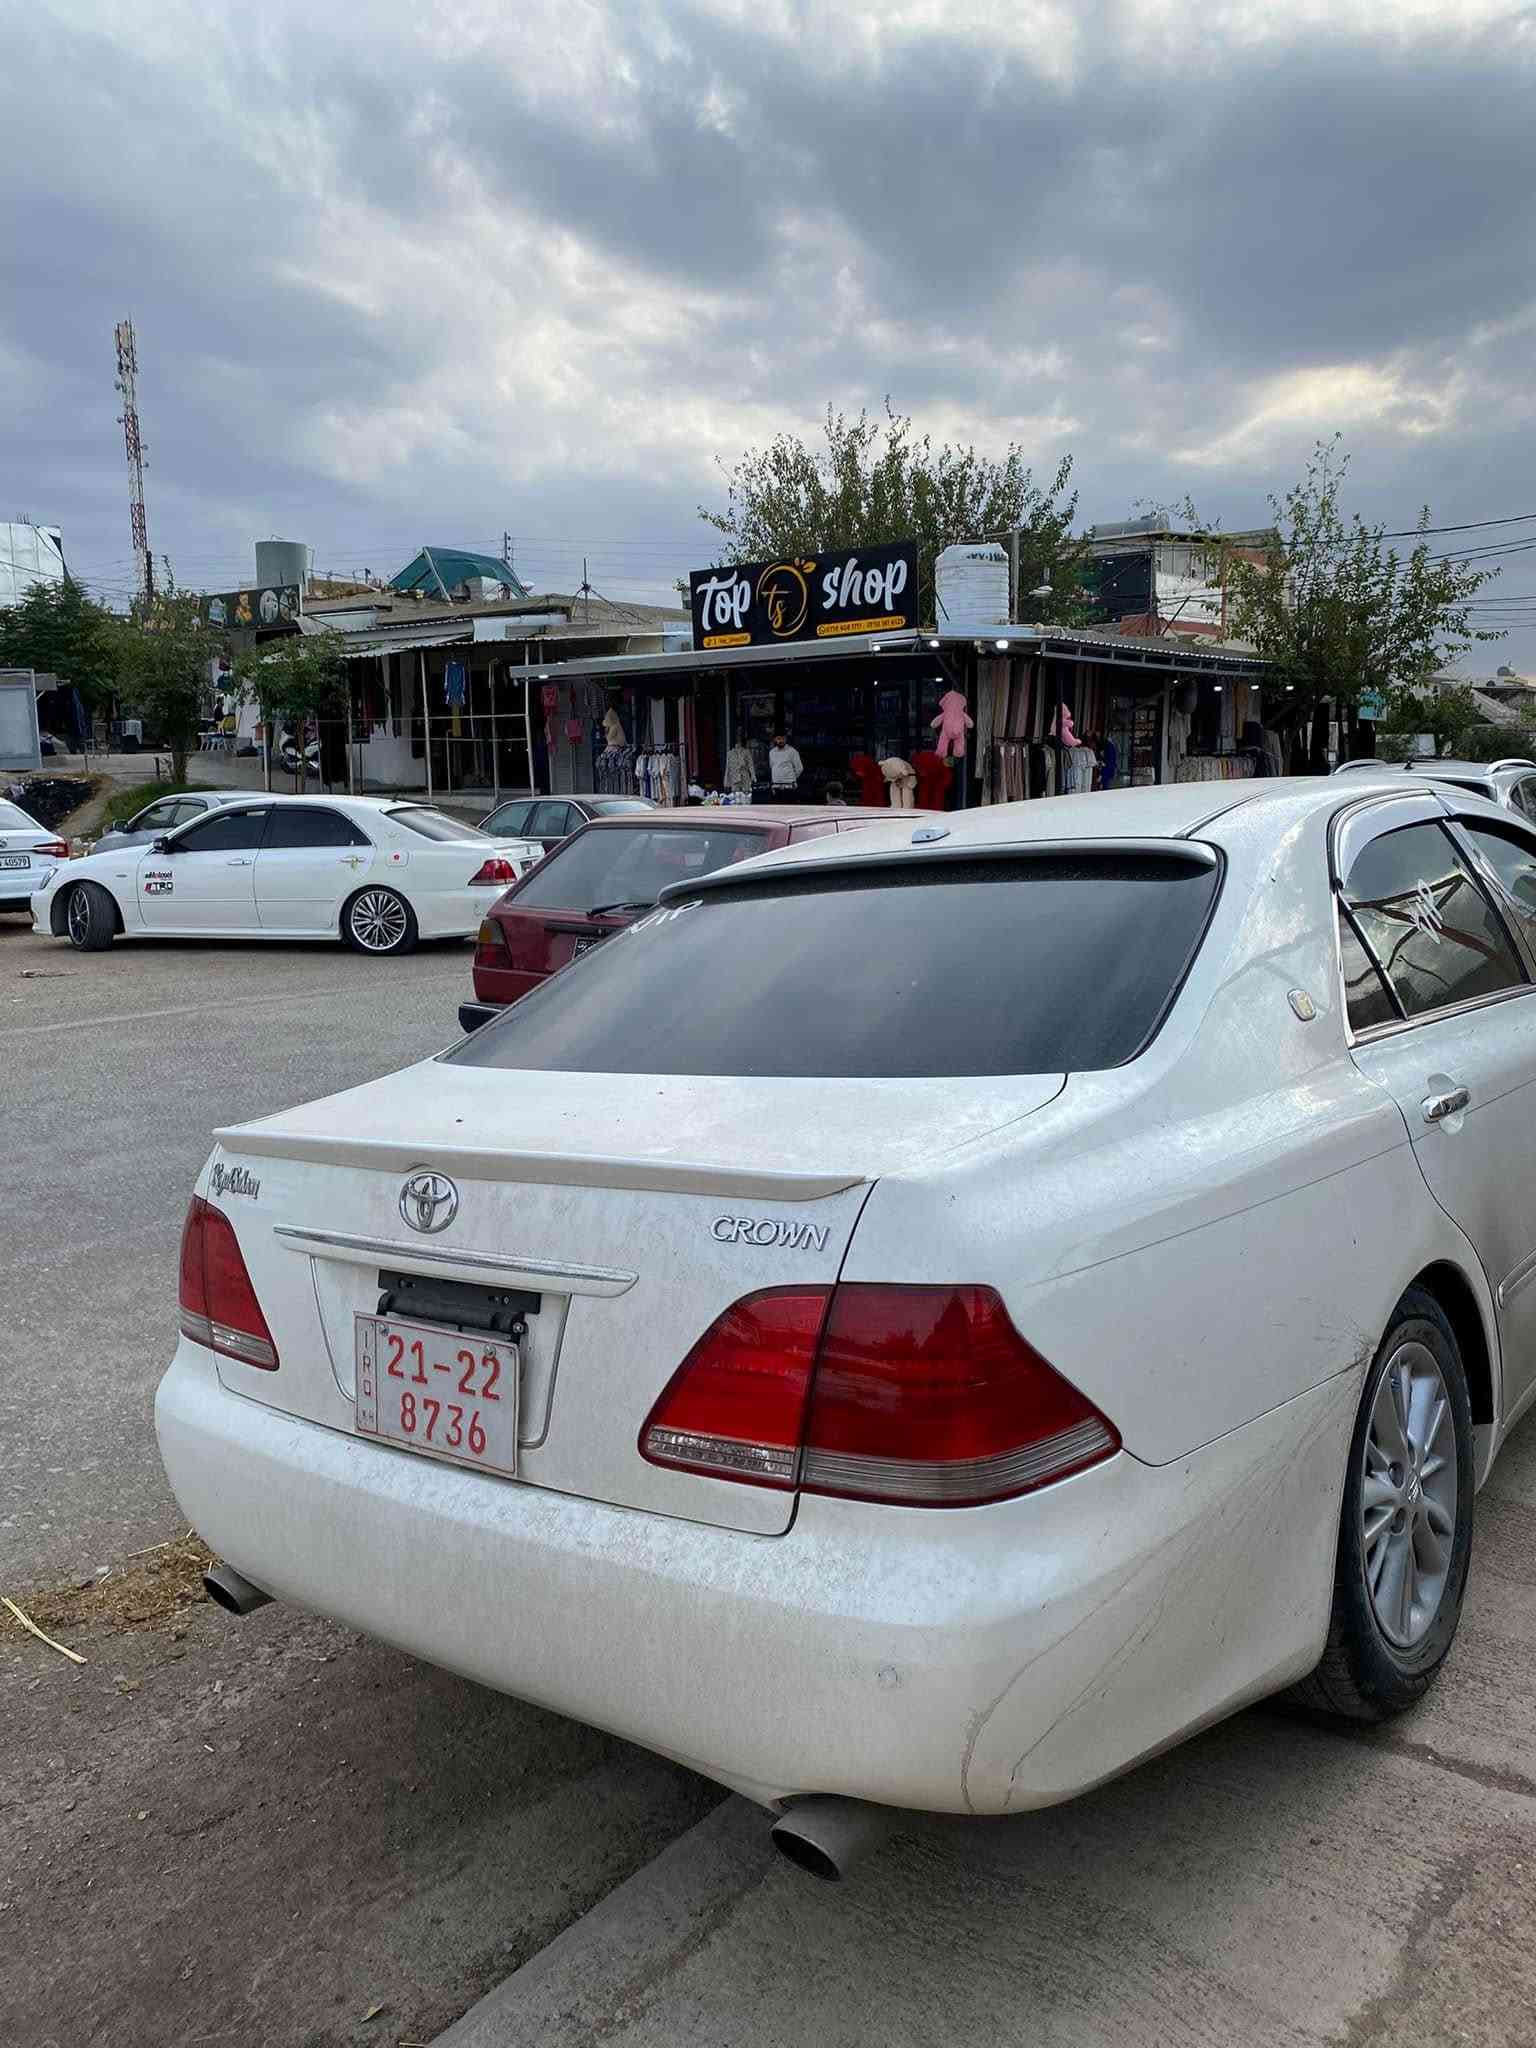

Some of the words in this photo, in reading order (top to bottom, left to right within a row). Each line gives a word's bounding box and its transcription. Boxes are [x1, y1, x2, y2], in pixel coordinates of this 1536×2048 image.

[696, 570, 750, 631] Top
[822, 557, 908, 611] shop
[710, 1216, 830, 1252] CROWN
[387, 1334, 500, 1401] 21-22
[400, 1391, 487, 1455] 8736
